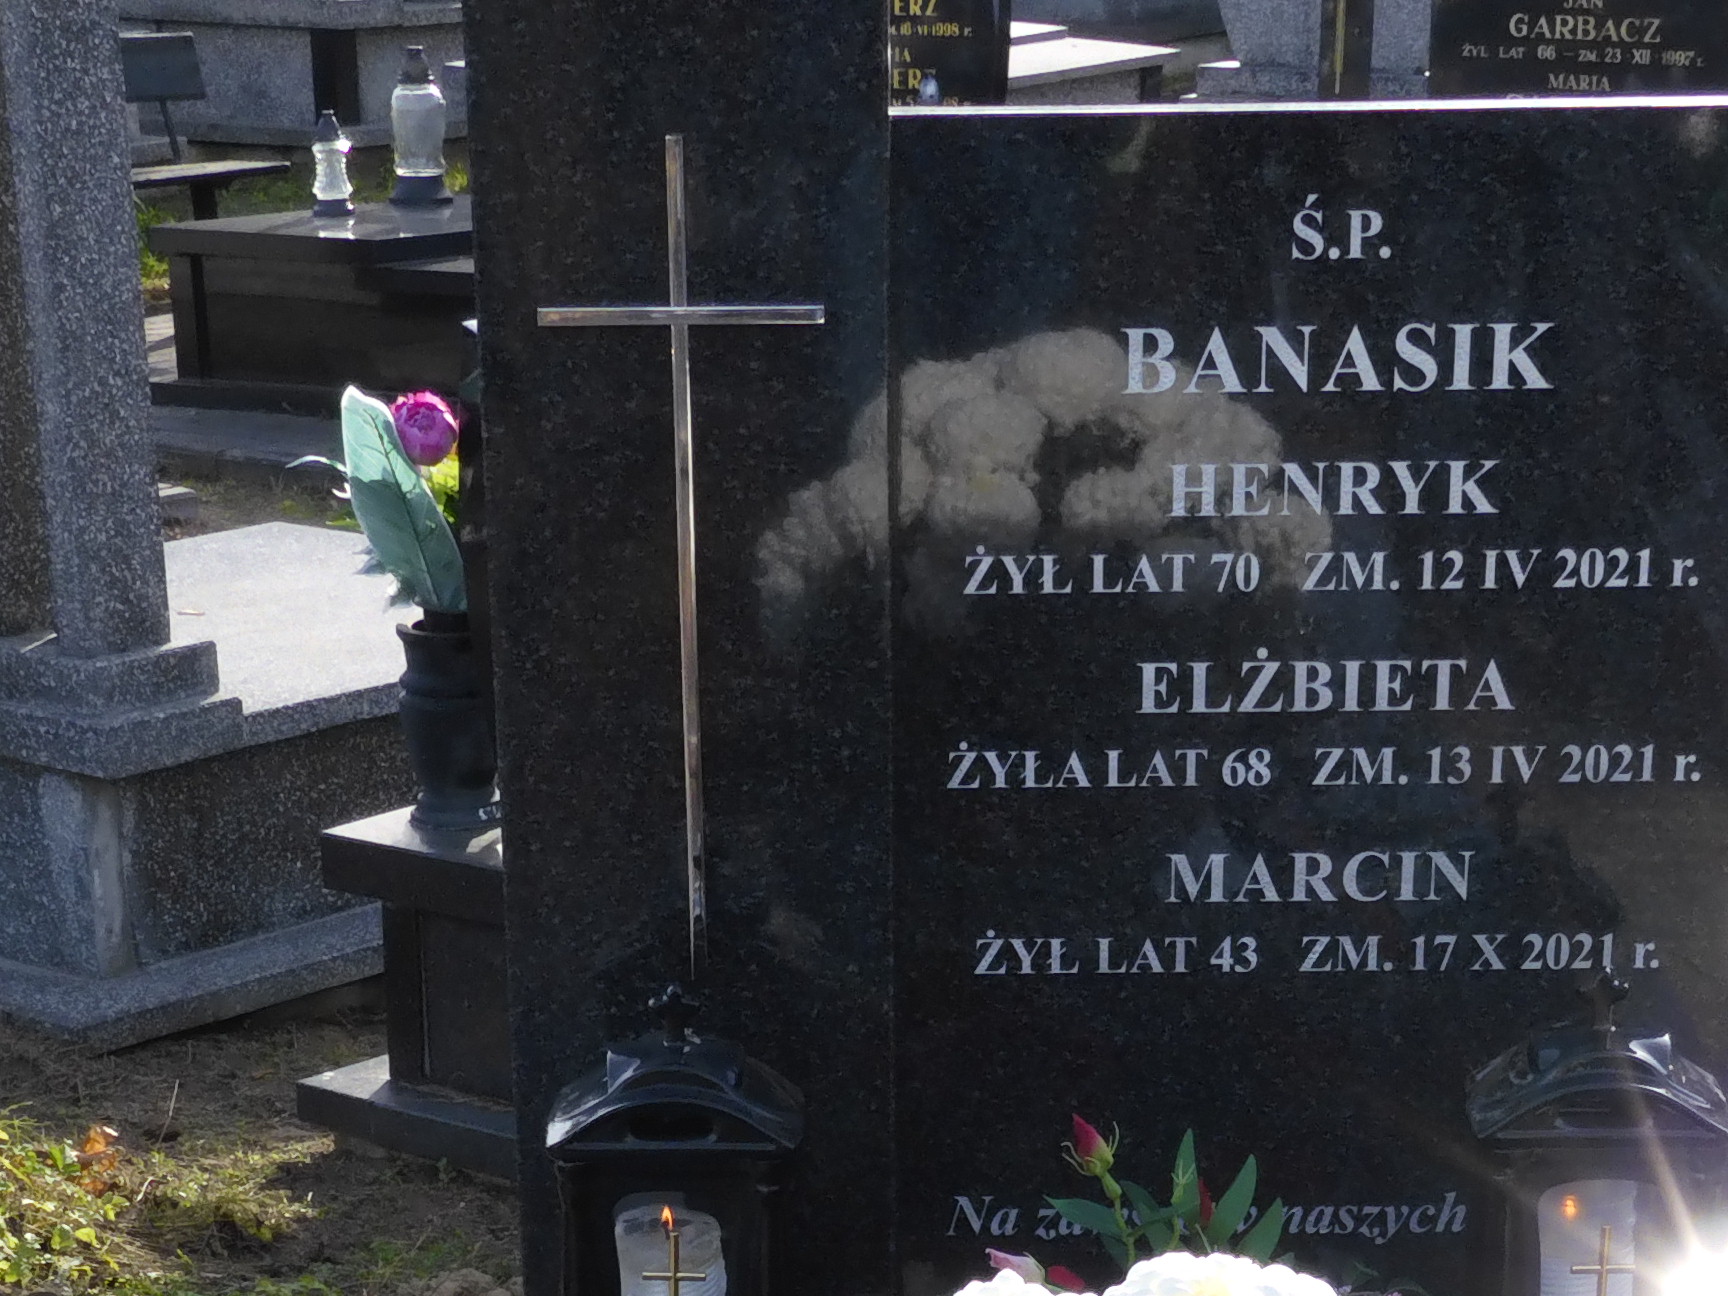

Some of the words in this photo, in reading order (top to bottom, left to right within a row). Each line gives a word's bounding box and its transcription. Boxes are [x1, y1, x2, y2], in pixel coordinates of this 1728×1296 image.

[1509, 13, 1661, 43] GARBACZ
[893, 68, 936, 89] ER
[1499, 46, 1525, 59] LAT
[1604, 48, 1621, 63] 23
[1548, 73, 1611, 91] MARIA
[1291, 193, 1392, 260] Ś.P.
[1122, 323, 1555, 395] BANASIK
[1168, 460, 1500, 517] HENRYK
[963, 544, 1072, 595] ŻYŁ
[1091, 552, 1196, 593] LAT
[1210, 551, 1260, 593] 70
[1301, 551, 1400, 591] ZM.
[1420, 549, 1464, 590] 12
[1482, 549, 1542, 589] IV
[1553, 547, 1651, 588] 2021
[1671, 558, 1699, 587] r.
[1137, 647, 1515, 714] ELŻBIETA
[947, 741, 1092, 789] ŻYŁA
[1105, 749, 1208, 787] LAT
[1221, 748, 1272, 787] 68
[1312, 747, 1409, 786] ZM.
[1427, 745, 1472, 785] 13
[1490, 745, 1546, 784] IV
[1559, 743, 1654, 783] 2021
[1673, 754, 1701, 782] r.
[1166, 850, 1475, 903] MARCIN
[974, 929, 1079, 975] ŻYŁ
[1096, 936, 1197, 974] LAT
[1210, 936, 1258, 973] 43
[1299, 935, 1393, 972] ZM.
[1412, 934, 1458, 971] 17
[1470, 934, 1506, 970] X
[1520, 932, 1615, 971] 2021
[1633, 942, 1660, 969] r.
[946, 1195, 1019, 1237] Na
[1280, 1191, 1469, 1246] naszych
